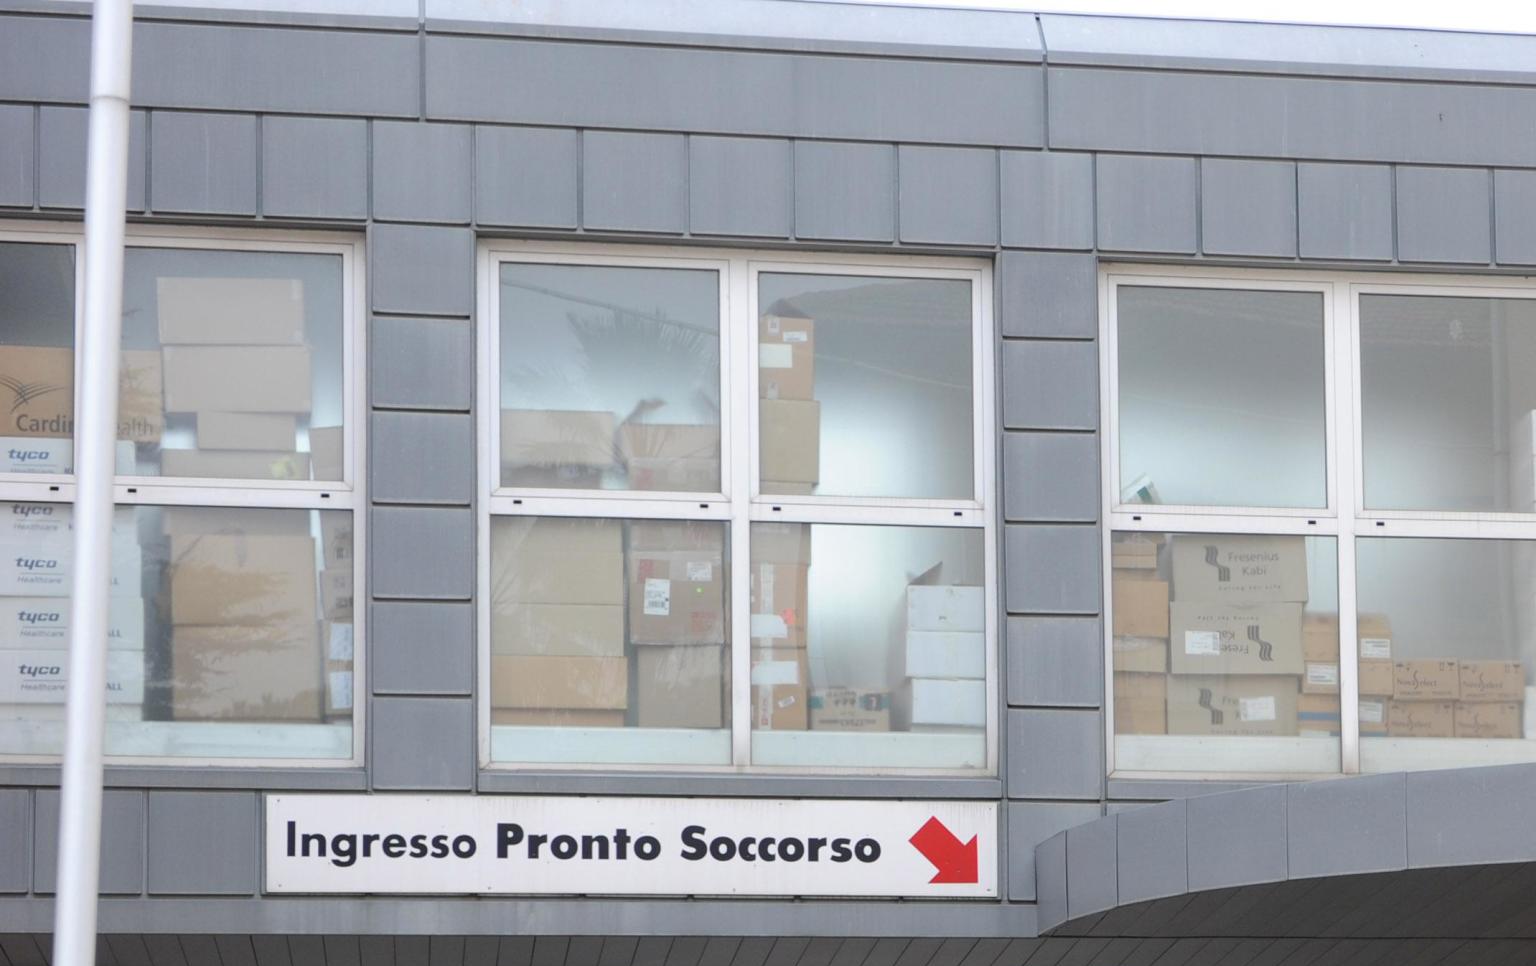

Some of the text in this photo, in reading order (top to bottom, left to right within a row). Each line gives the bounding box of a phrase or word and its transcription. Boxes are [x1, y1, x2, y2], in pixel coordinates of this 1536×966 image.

[8, 449, 50, 462] tyco
[12, 504, 53, 517] tyco
[16, 557, 57, 570] tyco
[1227, 552, 1280, 562] Fresenius
[1242, 567, 1267, 576] Kabi
[18, 611, 60, 624] tyco
[18, 664, 61, 677] tyco
[287, 820, 882, 867] Ingresso Pronto Soccorso
